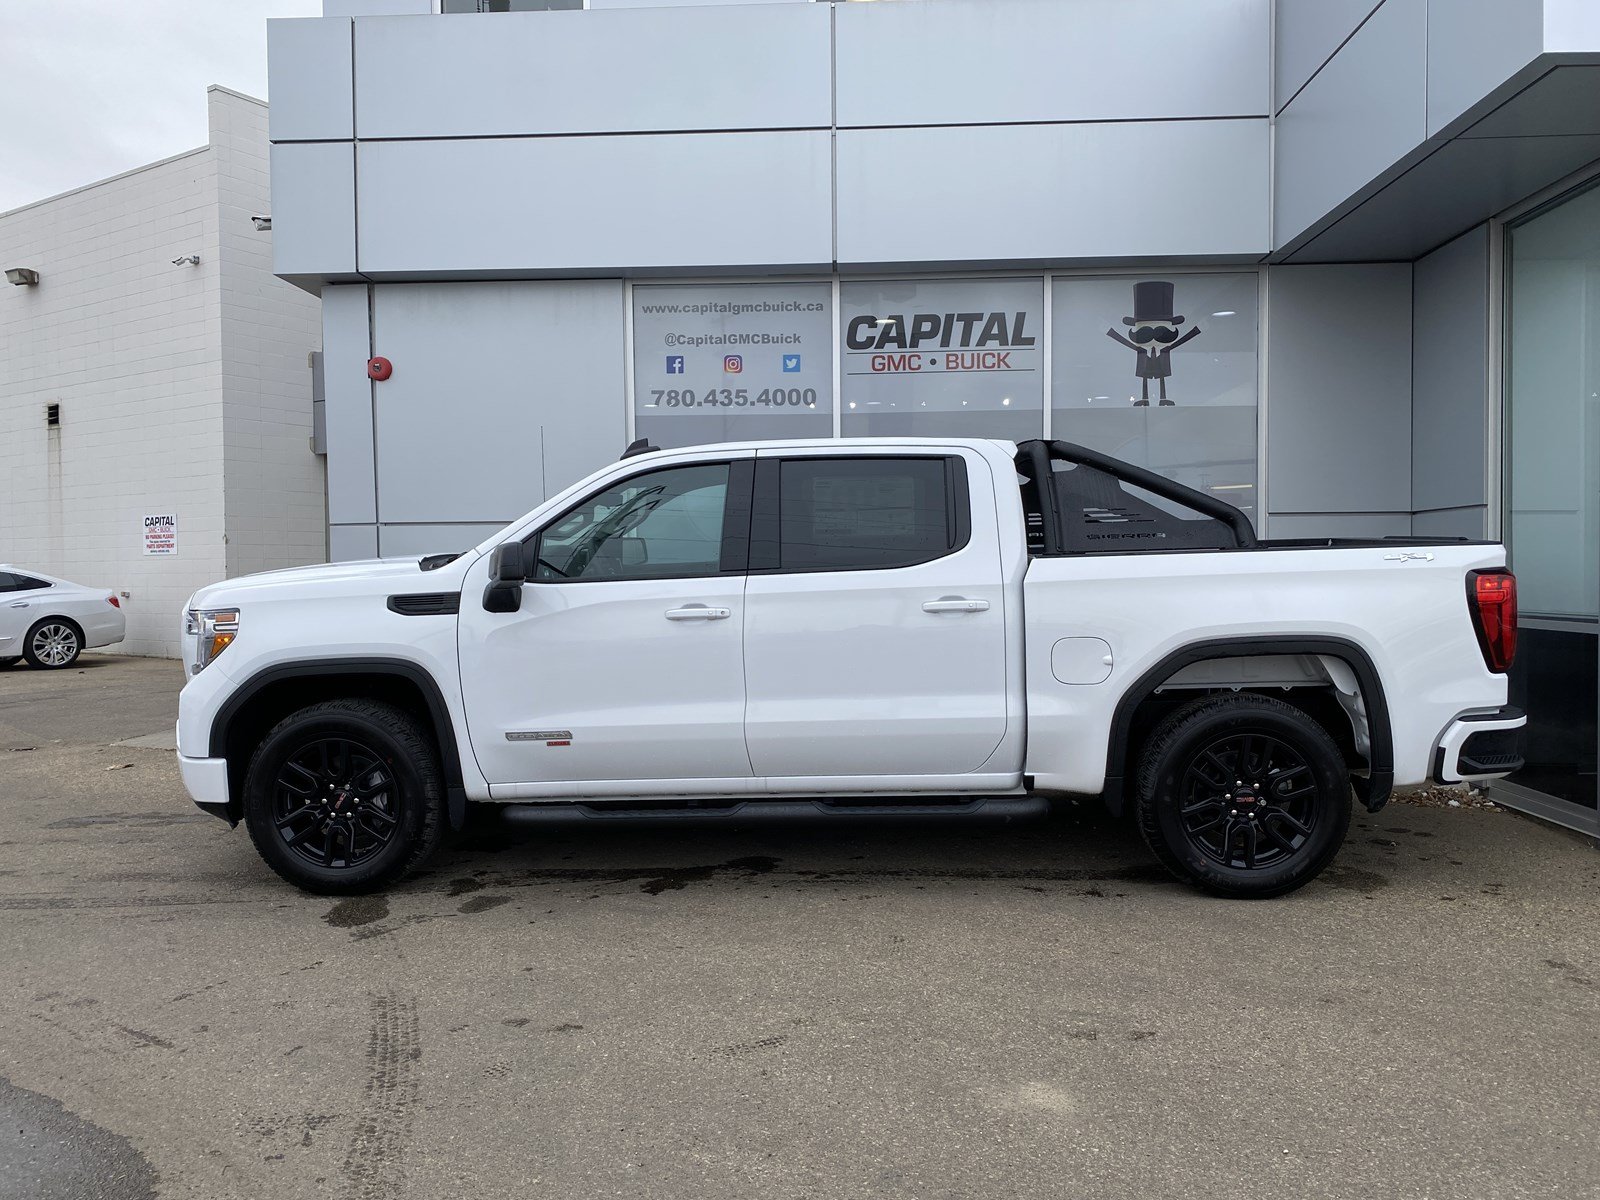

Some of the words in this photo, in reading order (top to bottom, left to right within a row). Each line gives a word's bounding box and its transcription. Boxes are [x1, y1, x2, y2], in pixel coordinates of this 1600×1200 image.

[642, 300, 824, 316] www.capitalgmcbuick.ca
[846, 311, 1036, 350] CAPITAL
[664, 332, 802, 348] @CapitalGMCBuick
[871, 353, 922, 373] GMC
[945, 351, 1012, 371] BUICK
[650, 387, 817, 408] 780.435.4000
[145, 516, 174, 526] CAPITAL
